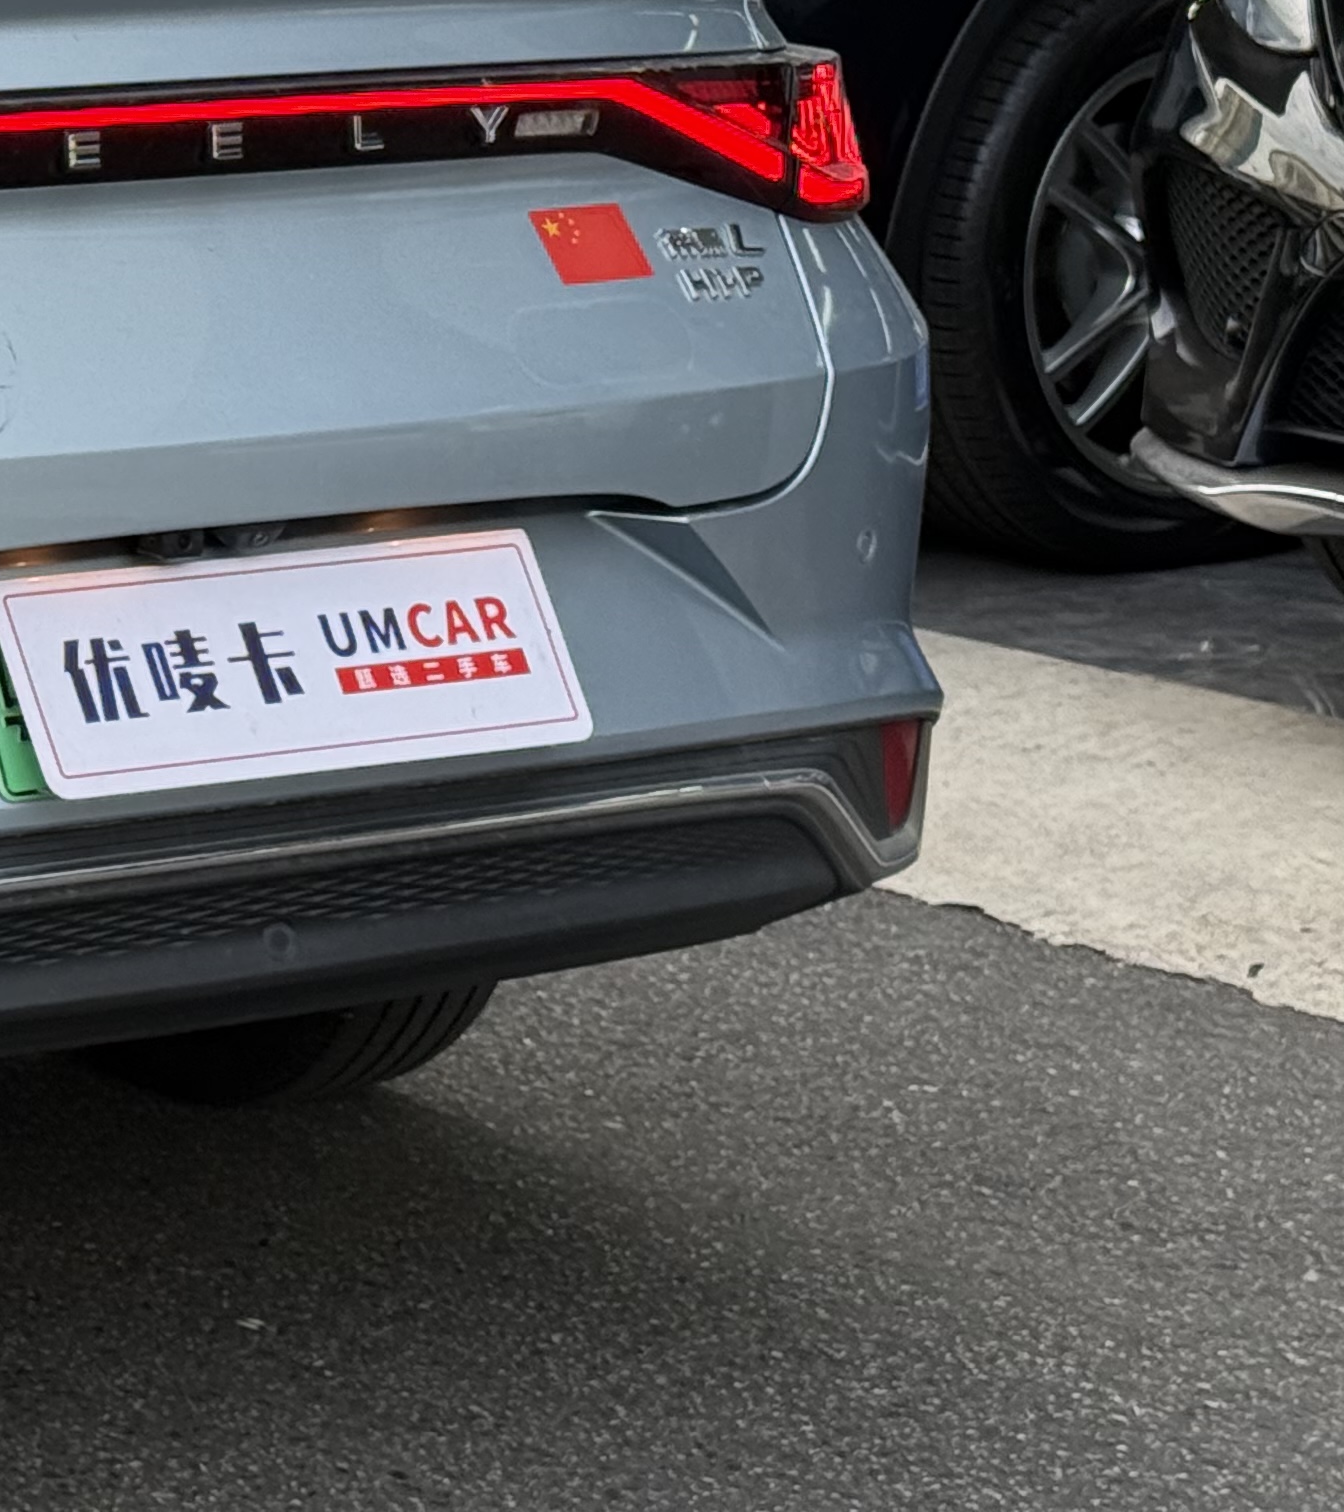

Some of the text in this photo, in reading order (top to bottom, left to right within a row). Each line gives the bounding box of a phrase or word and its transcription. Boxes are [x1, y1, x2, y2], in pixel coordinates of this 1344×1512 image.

[317, 596, 517, 658] UMCAR
[63, 621, 306, 724] 优唛卡
